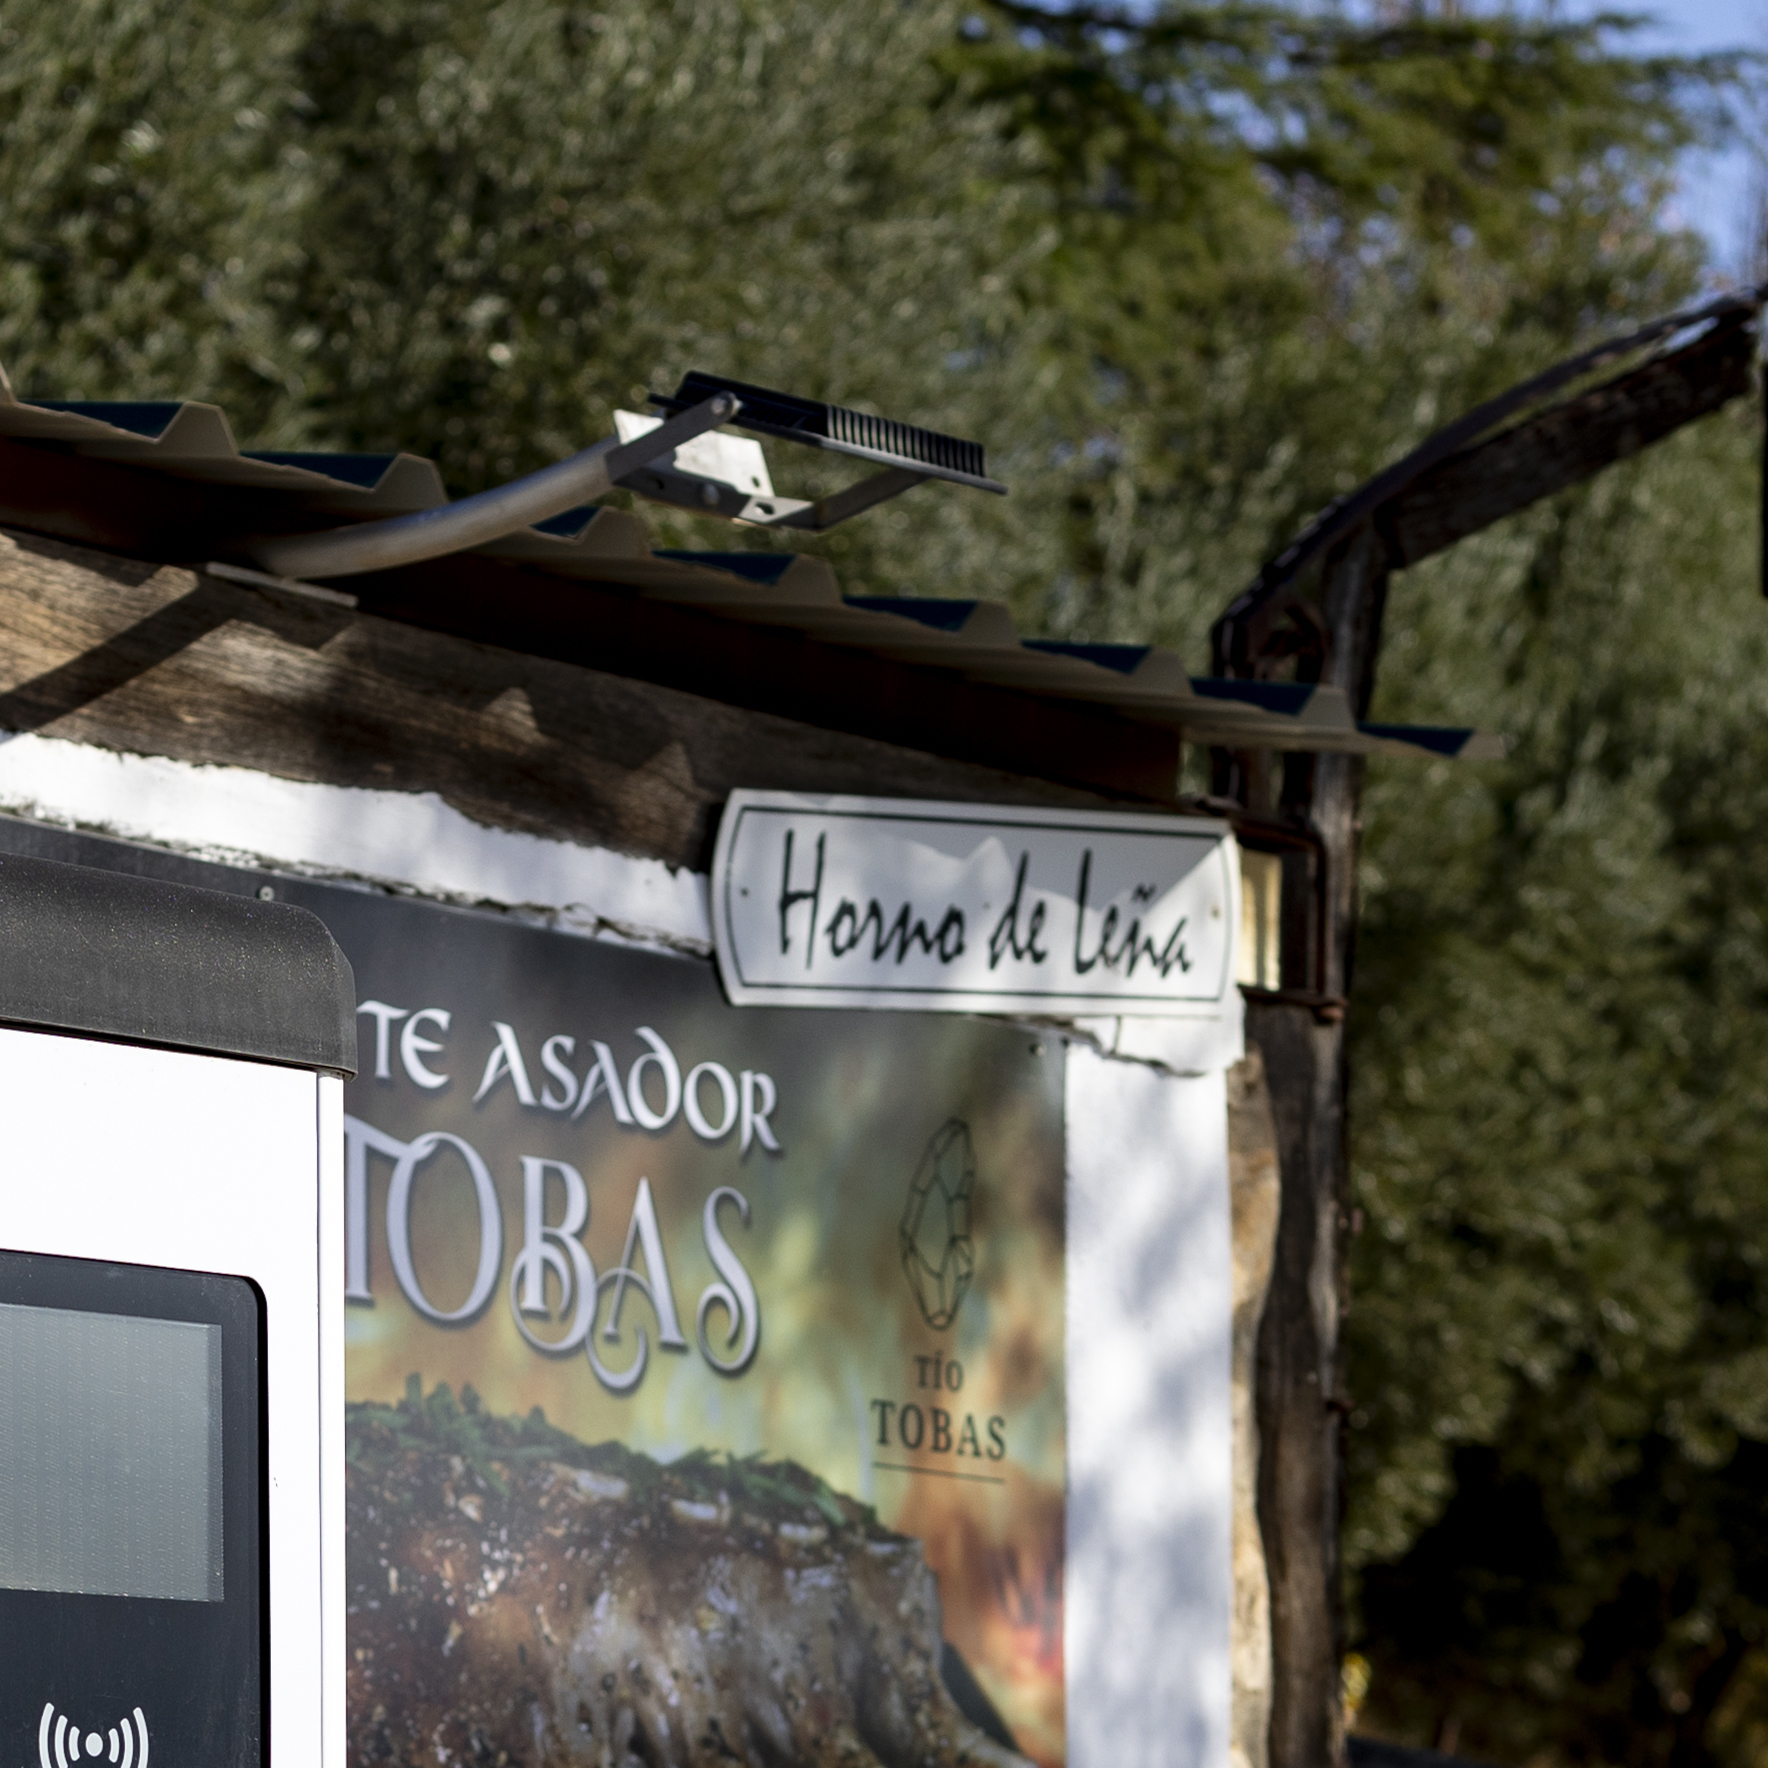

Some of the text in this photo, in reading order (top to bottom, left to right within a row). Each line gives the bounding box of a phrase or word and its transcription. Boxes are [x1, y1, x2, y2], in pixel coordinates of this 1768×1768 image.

[779, 829, 1193, 978] Horno de Leña
[473, 1020, 781, 1155] ASADOR
[344, 1113, 761, 1390] TOBAS
[870, 1398, 1007, 1461] TOBAS
[913, 1349, 964, 1392] TÍO
